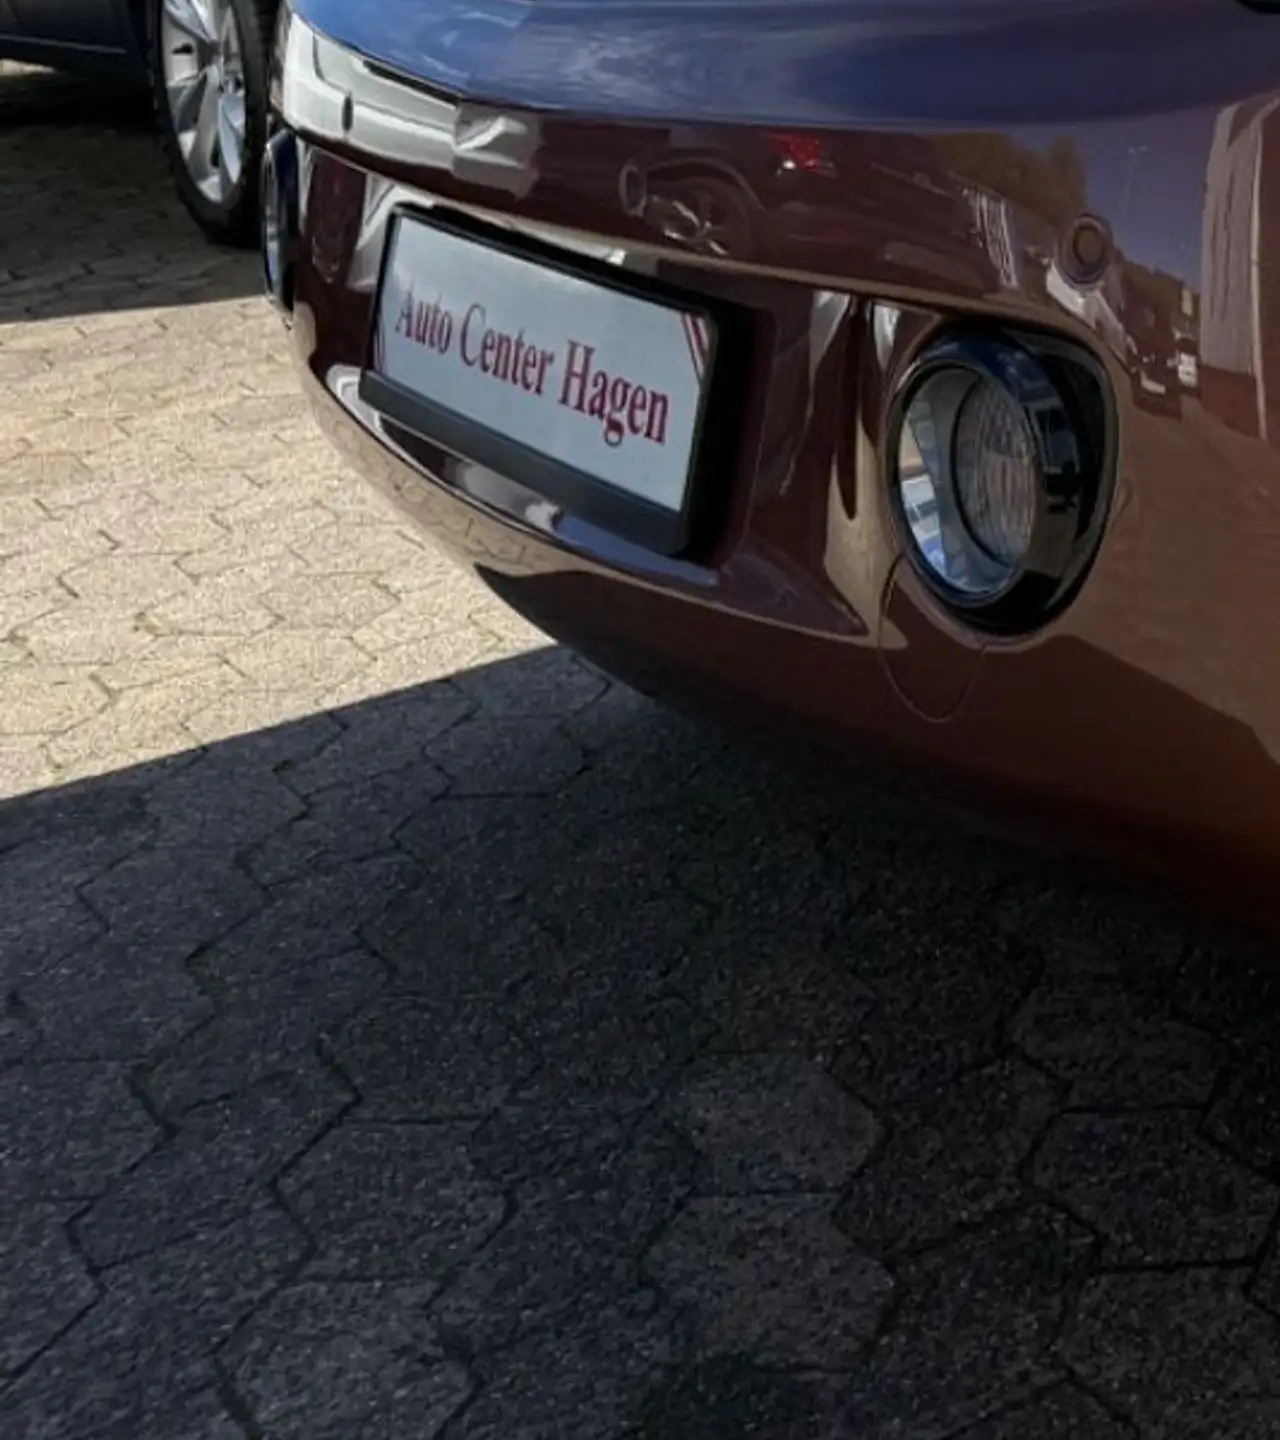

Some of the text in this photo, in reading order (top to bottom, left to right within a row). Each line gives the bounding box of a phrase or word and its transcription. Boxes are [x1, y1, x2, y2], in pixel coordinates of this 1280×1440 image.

[395, 292, 669, 447] Auto Center Hagen
